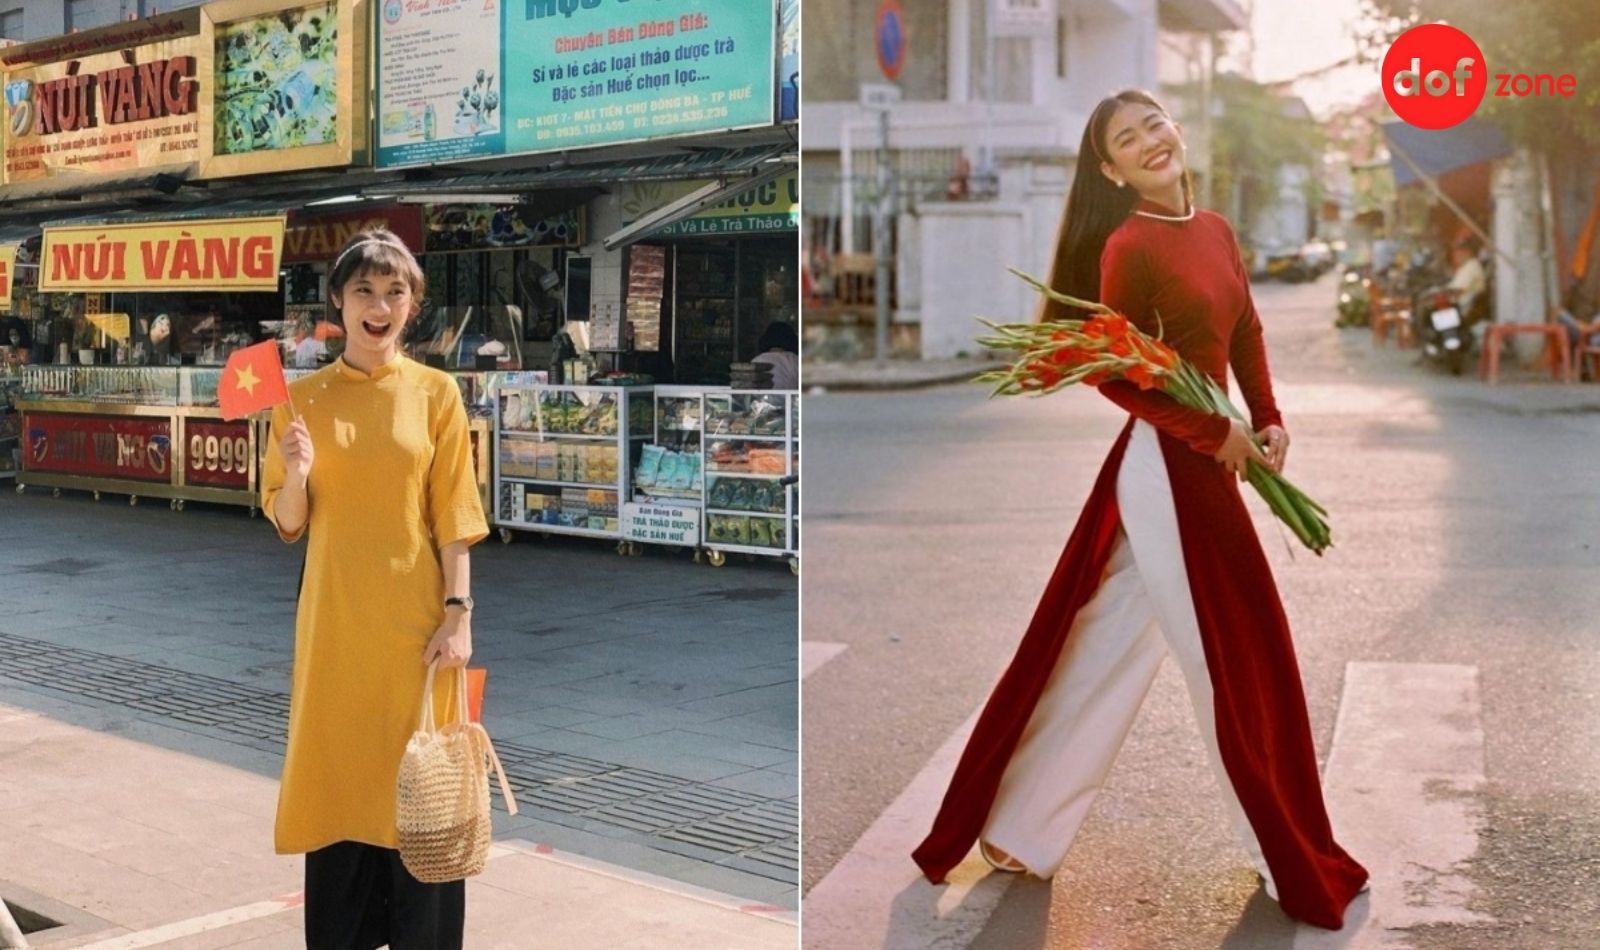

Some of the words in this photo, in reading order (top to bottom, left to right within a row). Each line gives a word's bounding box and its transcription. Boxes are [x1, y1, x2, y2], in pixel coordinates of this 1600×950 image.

[555, 32, 604, 54] Chuyên
[607, 26, 635, 45] Bán
[679, 12, 709, 33] Giá:
[549, 65, 564, 81] và
[583, 58, 607, 76] các
[611, 53, 636, 72] loại
[640, 47, 670, 66] thảo
[675, 43, 710, 62] dược
[714, 37, 736, 55] trà
[35, 60, 97, 136] NÚI
[98, 49, 198, 124] VÀNG
[552, 85, 577, 104] Đặc
[580, 80, 604, 98] sản
[607, 72, 634, 94] Huế
[637, 74, 671, 92] chọn
[52, 233, 126, 281] NÚI
[141, 231, 274, 280] VÀNG
[191, 434, 248, 474] 9999
